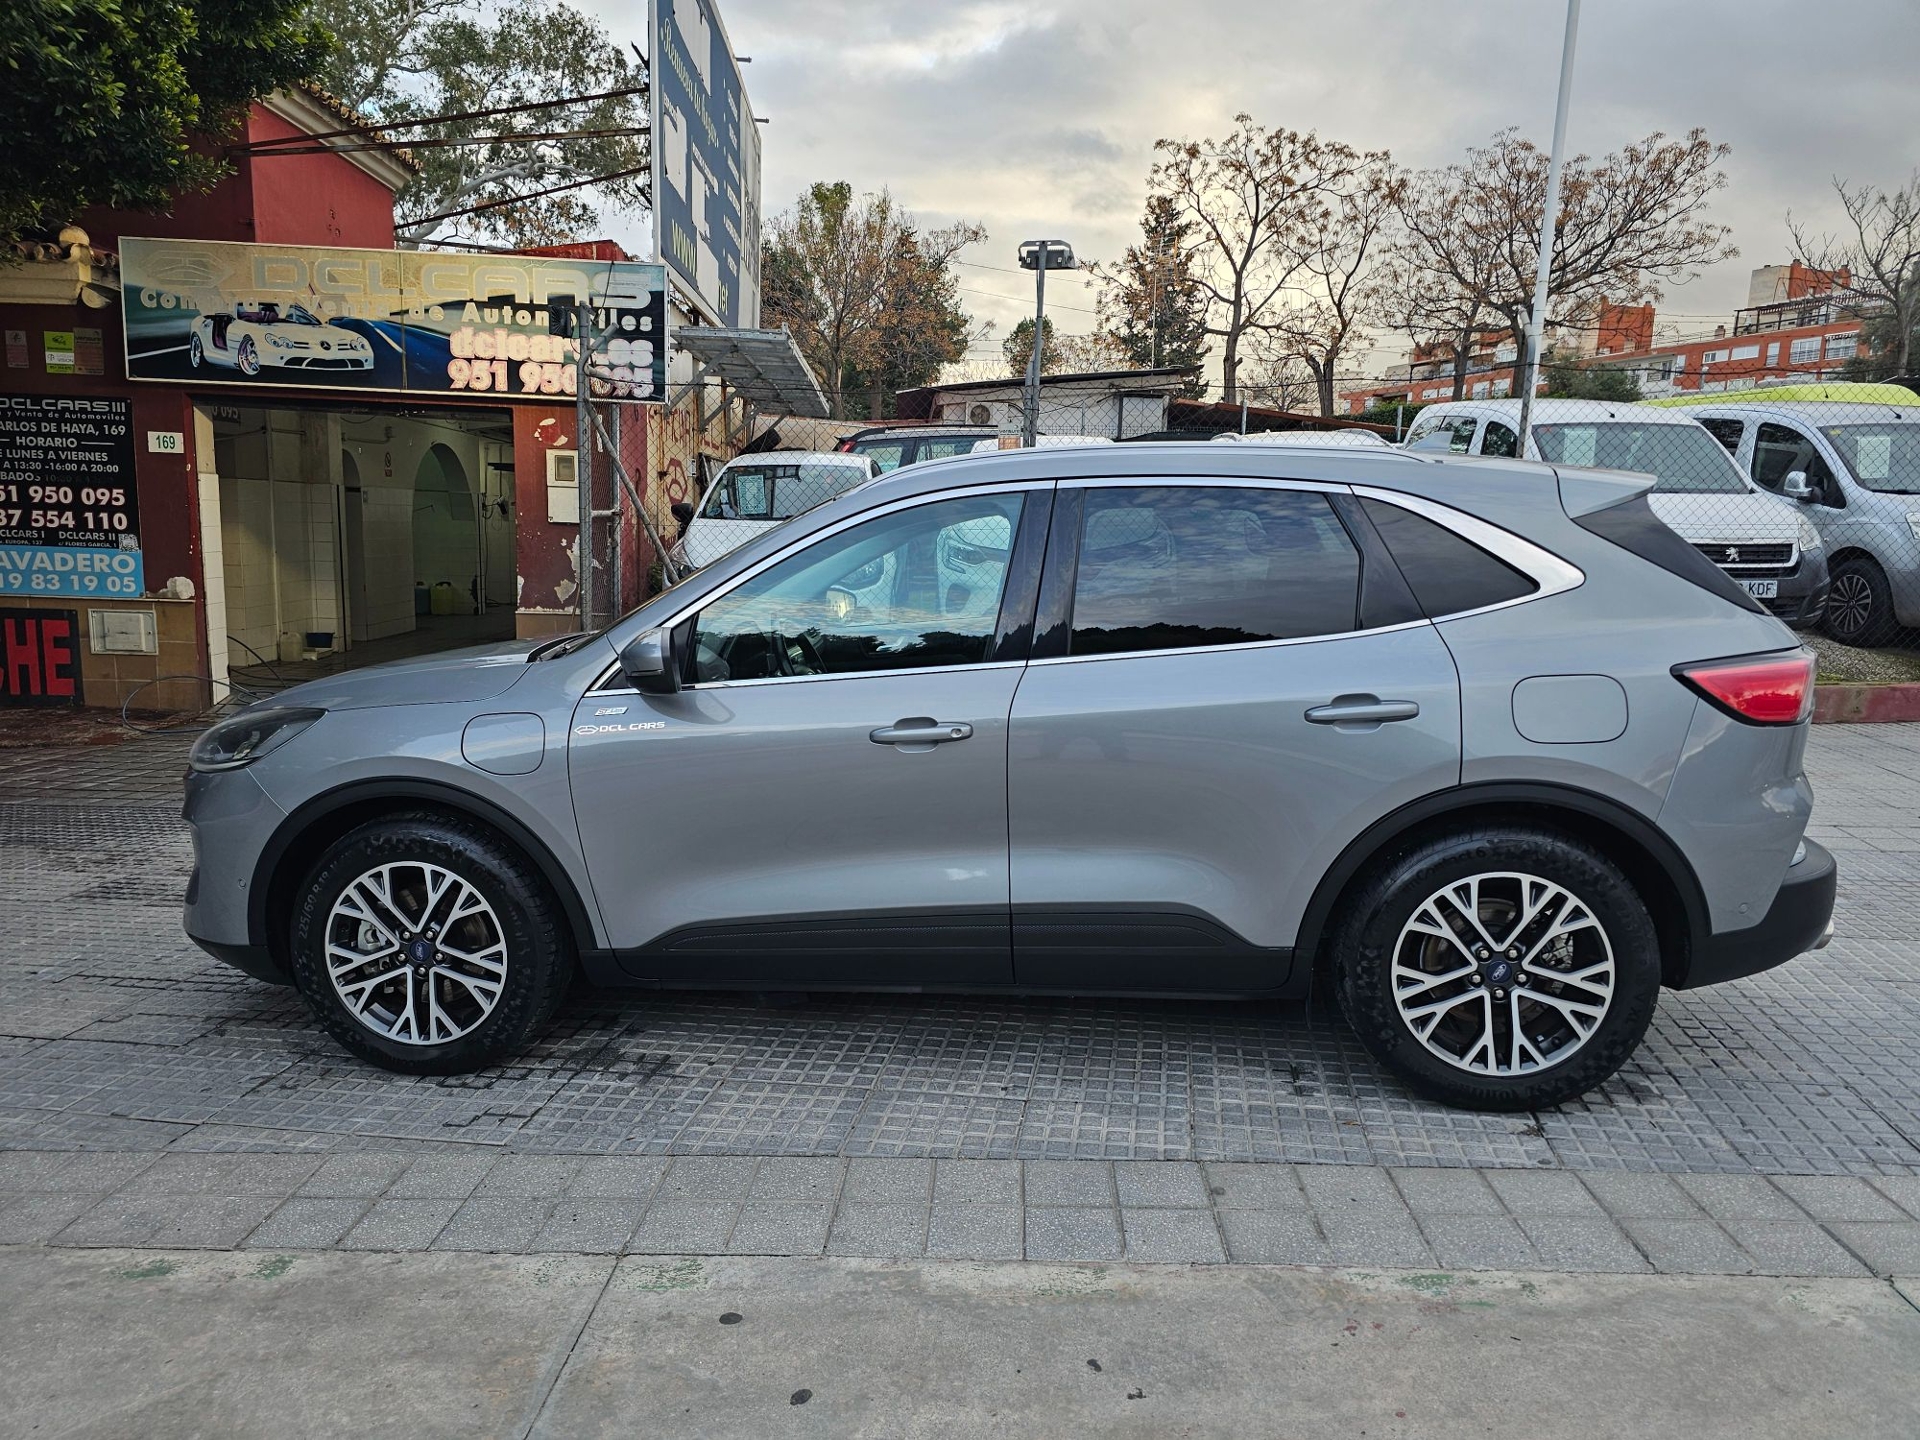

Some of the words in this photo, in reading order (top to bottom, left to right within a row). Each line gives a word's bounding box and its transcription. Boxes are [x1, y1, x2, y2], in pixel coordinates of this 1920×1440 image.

[408, 300, 445, 322] de
[461, 302, 653, 332] Automiles
[447, 358, 509, 392] 951
[590, 365, 655, 398] 095
[14, 410, 43, 418] Venta
[48, 411, 60, 419] de
[41, 422, 58, 433] DE
[61, 423, 99, 436] HAYA,
[103, 425, 126, 435] 169
[15, 436, 78, 448] HORARIO
[155, 434, 176, 450] 169
[6, 449, 44, 459] LUNES
[47, 451, 56, 460] A
[58, 451, 109, 461] VIERNES
[3, 461, 11, 469] A
[14, 462, 42, 470] 13:30
[80, 464, 88, 472] A
[90, 464, 119, 473] 20:00
[28, 486, 73, 504] 950
[81, 487, 126, 506] 095
[31, 510, 76, 529] 554
[83, 512, 128, 531] 110
[58, 531, 106, 540] DCLCARS
[109, 532, 116, 541] II
[31, 573, 61, 590] 83
[69, 575, 99, 592] 19
[106, 576, 137, 593] 05
[1748, 581, 1774, 596] KDF
[0, 618, 75, 696] HE
[599, 724, 627, 733] DCL
[629, 721, 666, 731] CARS
